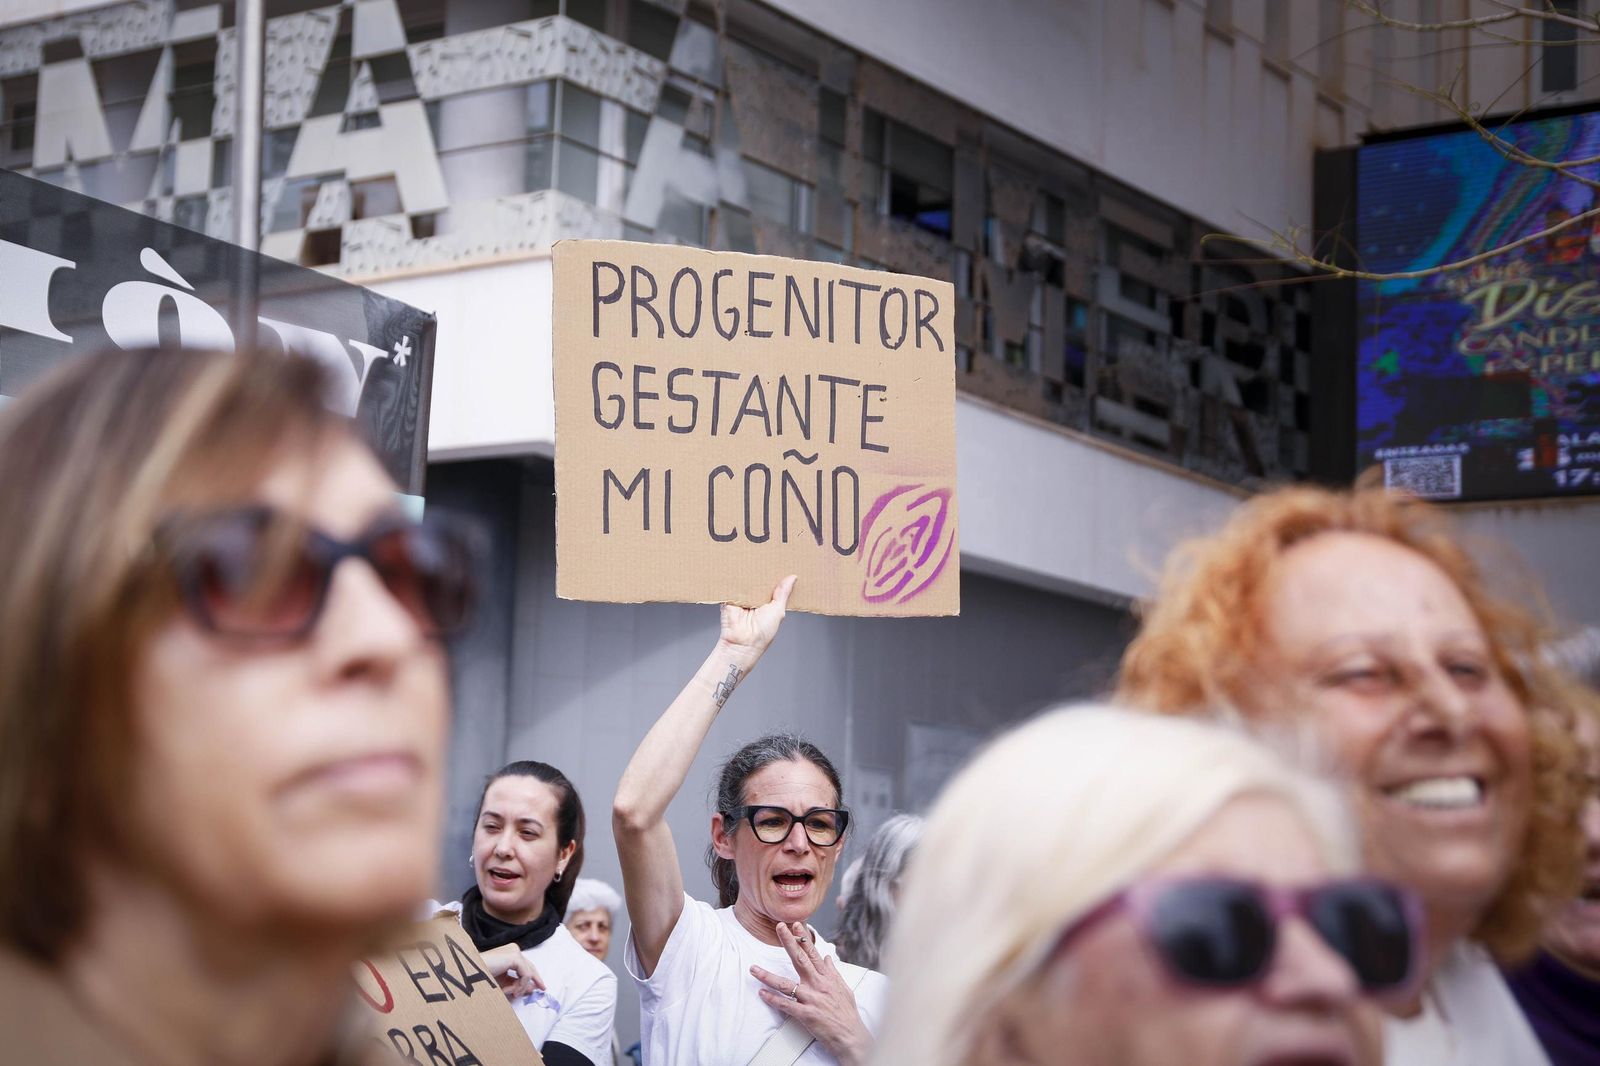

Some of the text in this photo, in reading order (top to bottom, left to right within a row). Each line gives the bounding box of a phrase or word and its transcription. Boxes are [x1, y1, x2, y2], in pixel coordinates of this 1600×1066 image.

[592, 261, 945, 352] PROGENITOR
[592, 361, 890, 453] GESTANTE
[603, 449, 860, 556] MI COÑO
[396, 933, 498, 1004] ERA
